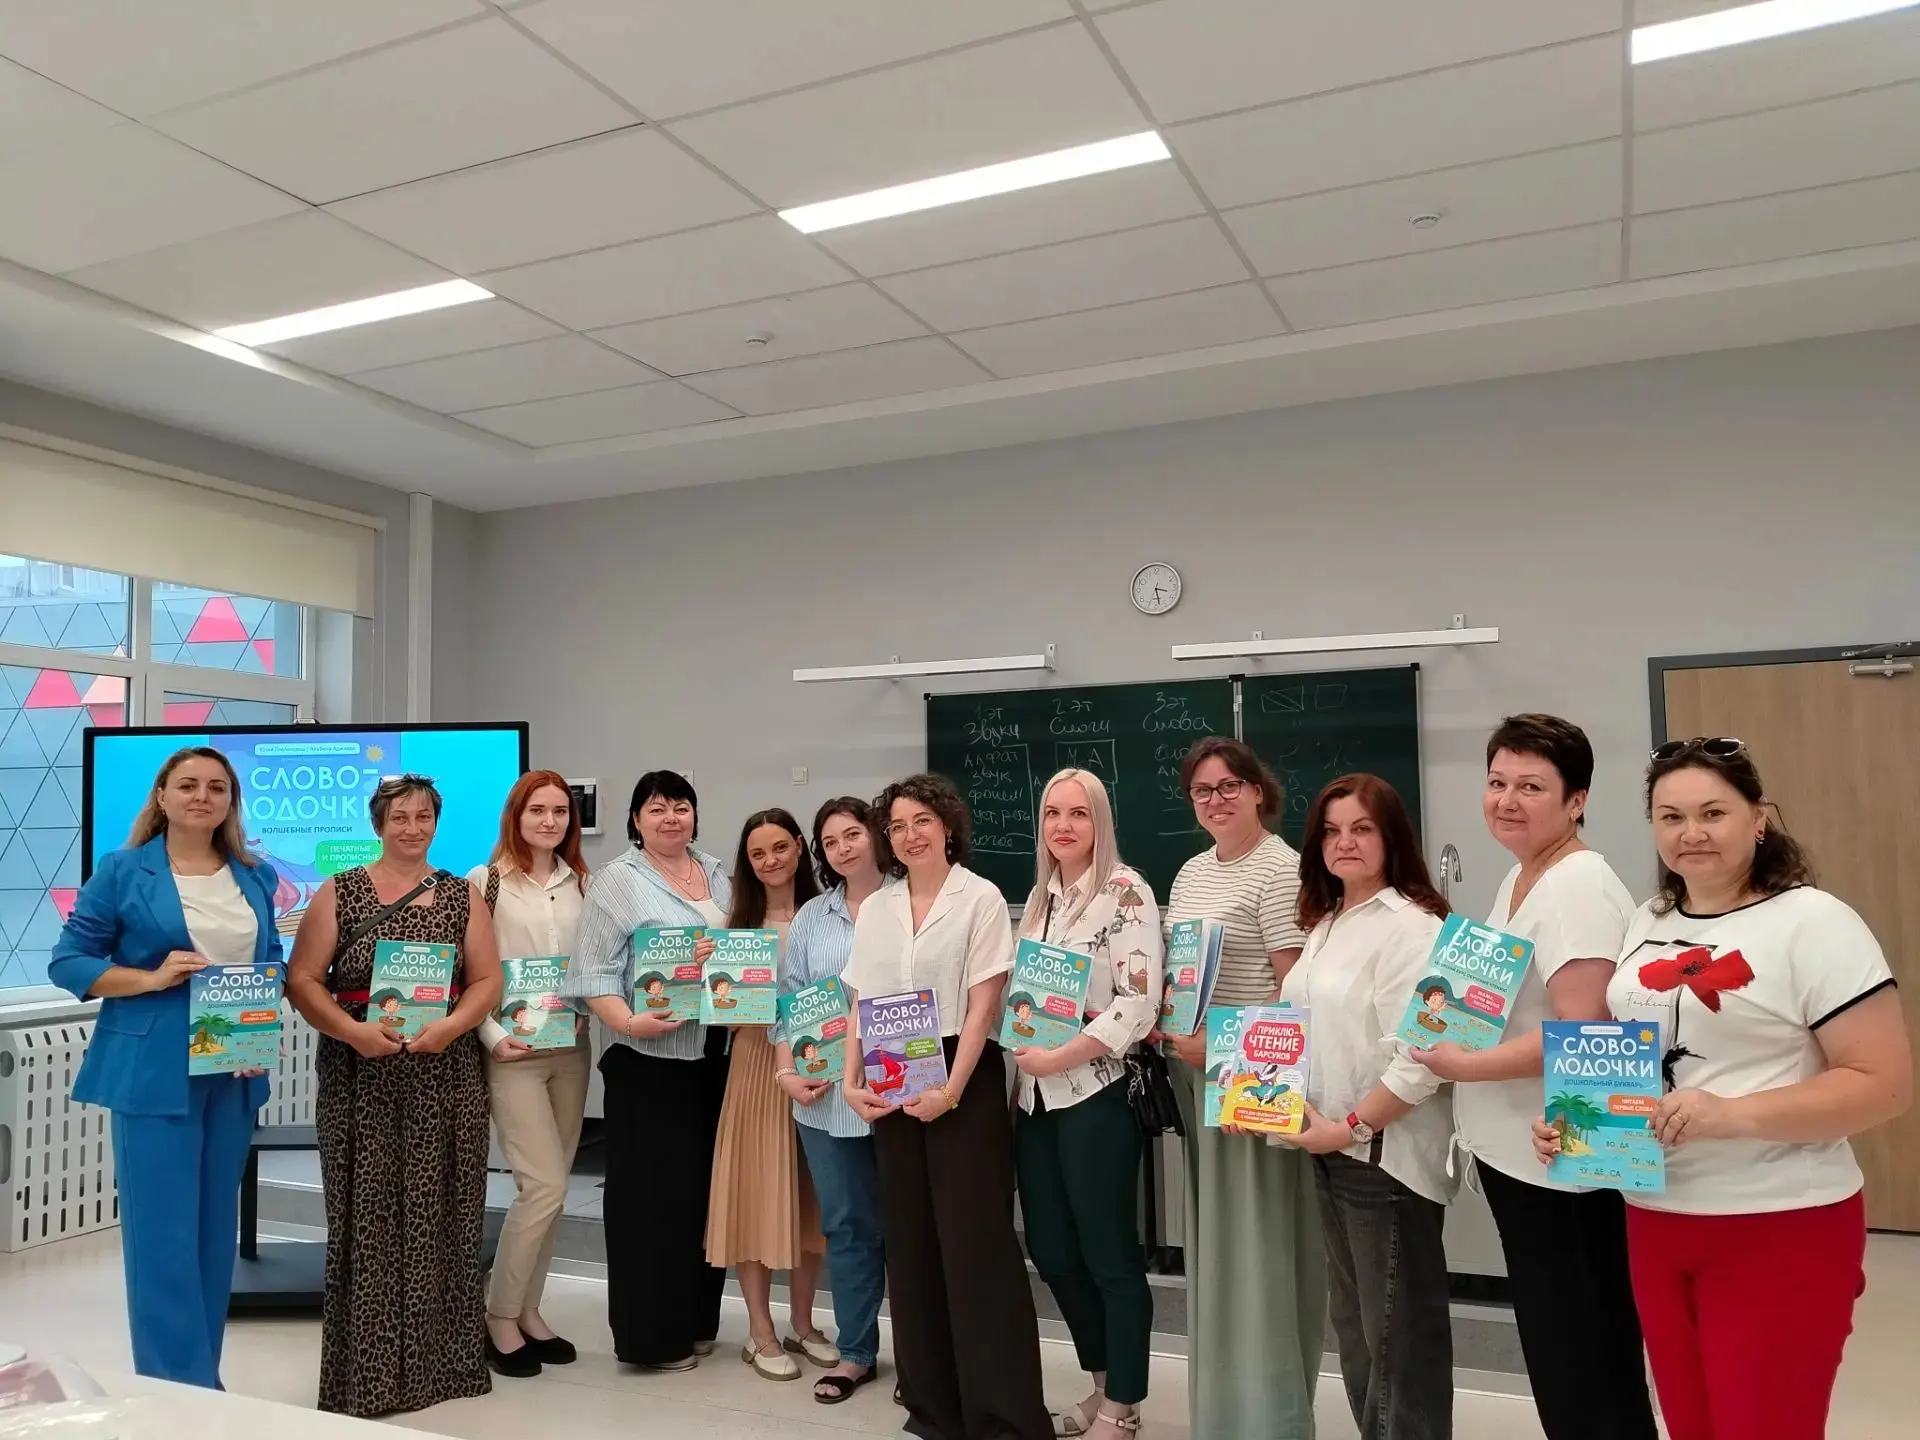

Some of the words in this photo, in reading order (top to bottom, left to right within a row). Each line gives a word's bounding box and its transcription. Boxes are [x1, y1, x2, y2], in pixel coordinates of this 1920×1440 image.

[250, 765, 379, 791] СЛОВО-
[330, 845, 371, 853] ПЕЧАТНЫЕ
[717, 938, 770, 949] СЛОВО-
[1450, 932, 1516, 963] СЛОВО-
[390, 952, 446, 966] СЛОВО-
[641, 947, 695, 960] ЛОДОЧК
[709, 950, 772, 961] ЛОДОЧКИ
[380, 964, 446, 979] ЛОДОЧКИ
[1027, 953, 1081, 975] СЛОВО-
[1436, 944, 1514, 985] ЛОДОЧКИ
[208, 973, 274, 989] СЛОВО-
[1018, 965, 1080, 993] ЛОДОЧКИ
[199, 986, 276, 1002] ЛОДОЧКИ
[789, 990, 835, 1014] СЛОВО-
[1626, 991, 1673, 1008] Fashion
[788, 997, 841, 1028] ЛОДОЧКИ
[871, 1003, 928, 1022] СЛОВО-
[866, 1015, 933, 1037] ЛОДОЧКИ
[1256, 1024, 1299, 1037] ПРИКЛЮ-
[1248, 1035, 1300, 1052] ЧТЕНИЕ
[1563, 1036, 1650, 1056] СЛОВО-
[1253, 1050, 1291, 1060] БАРСУКОВ
[1553, 1057, 1654, 1078] ЛОДОЧКИ
[1564, 1079, 1613, 1087] ДОШКОЛЬНЫЙ
[1614, 1080, 1644, 1088] БУКВАРЬ
